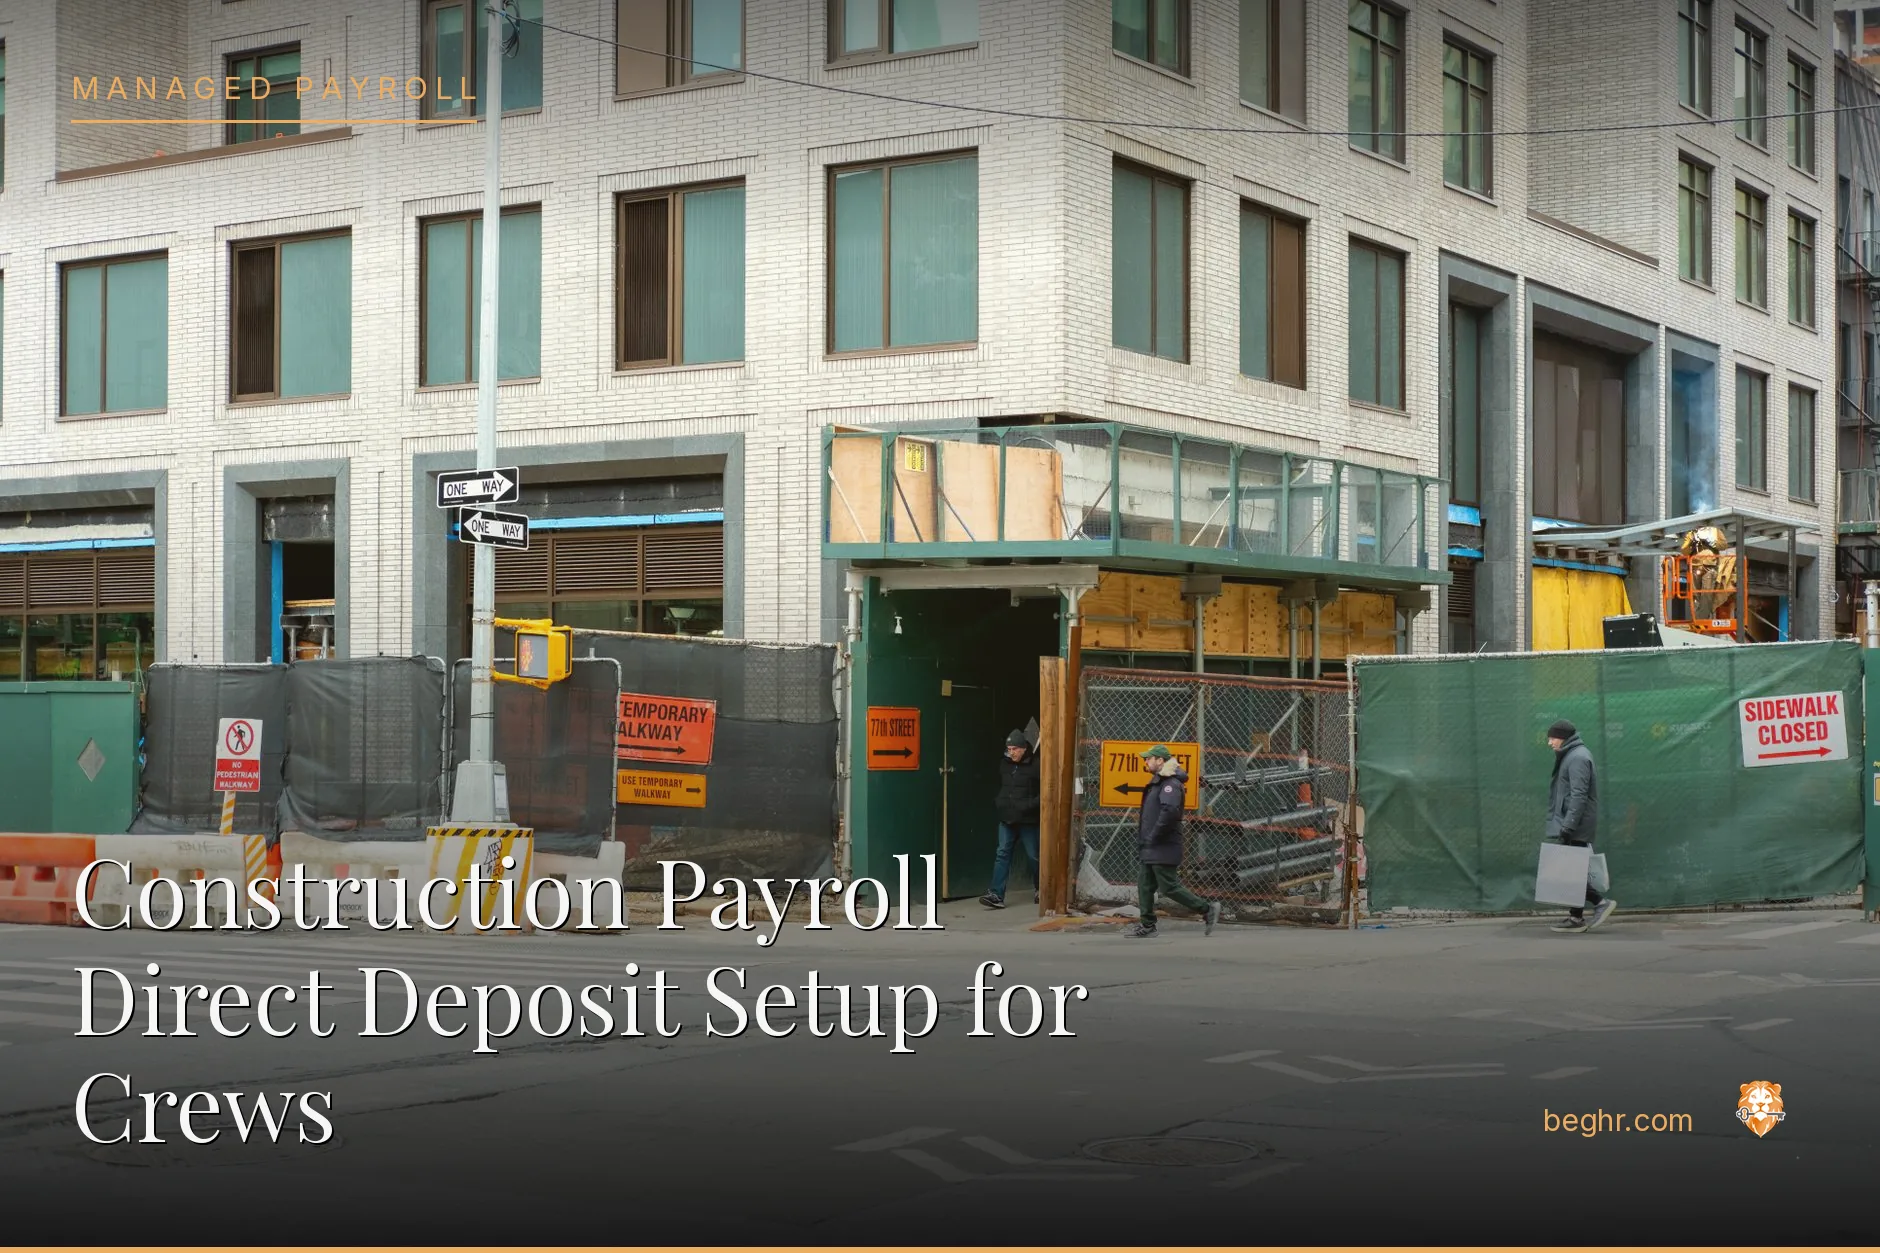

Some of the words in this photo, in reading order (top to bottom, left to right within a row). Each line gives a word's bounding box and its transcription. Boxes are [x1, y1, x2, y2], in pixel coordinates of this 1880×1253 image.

[446, 482, 468, 497] ONE
[482, 479, 504, 494] WAY
[471, 519, 490, 534] ONE
[502, 523, 521, 538] WAY
[1744, 694, 1839, 722] SIDEWALK
[617, 721, 683, 741] ALKWAY
[870, 718, 888, 737] 77th
[889, 718, 916, 737] STREET
[1757, 720, 1829, 746] CLOSED
[1109, 752, 1139, 773] 77th
[622, 776, 637, 785] USE
[638, 776, 683, 789] TEMPORARY
[634, 789, 671, 799] WALKWAY
